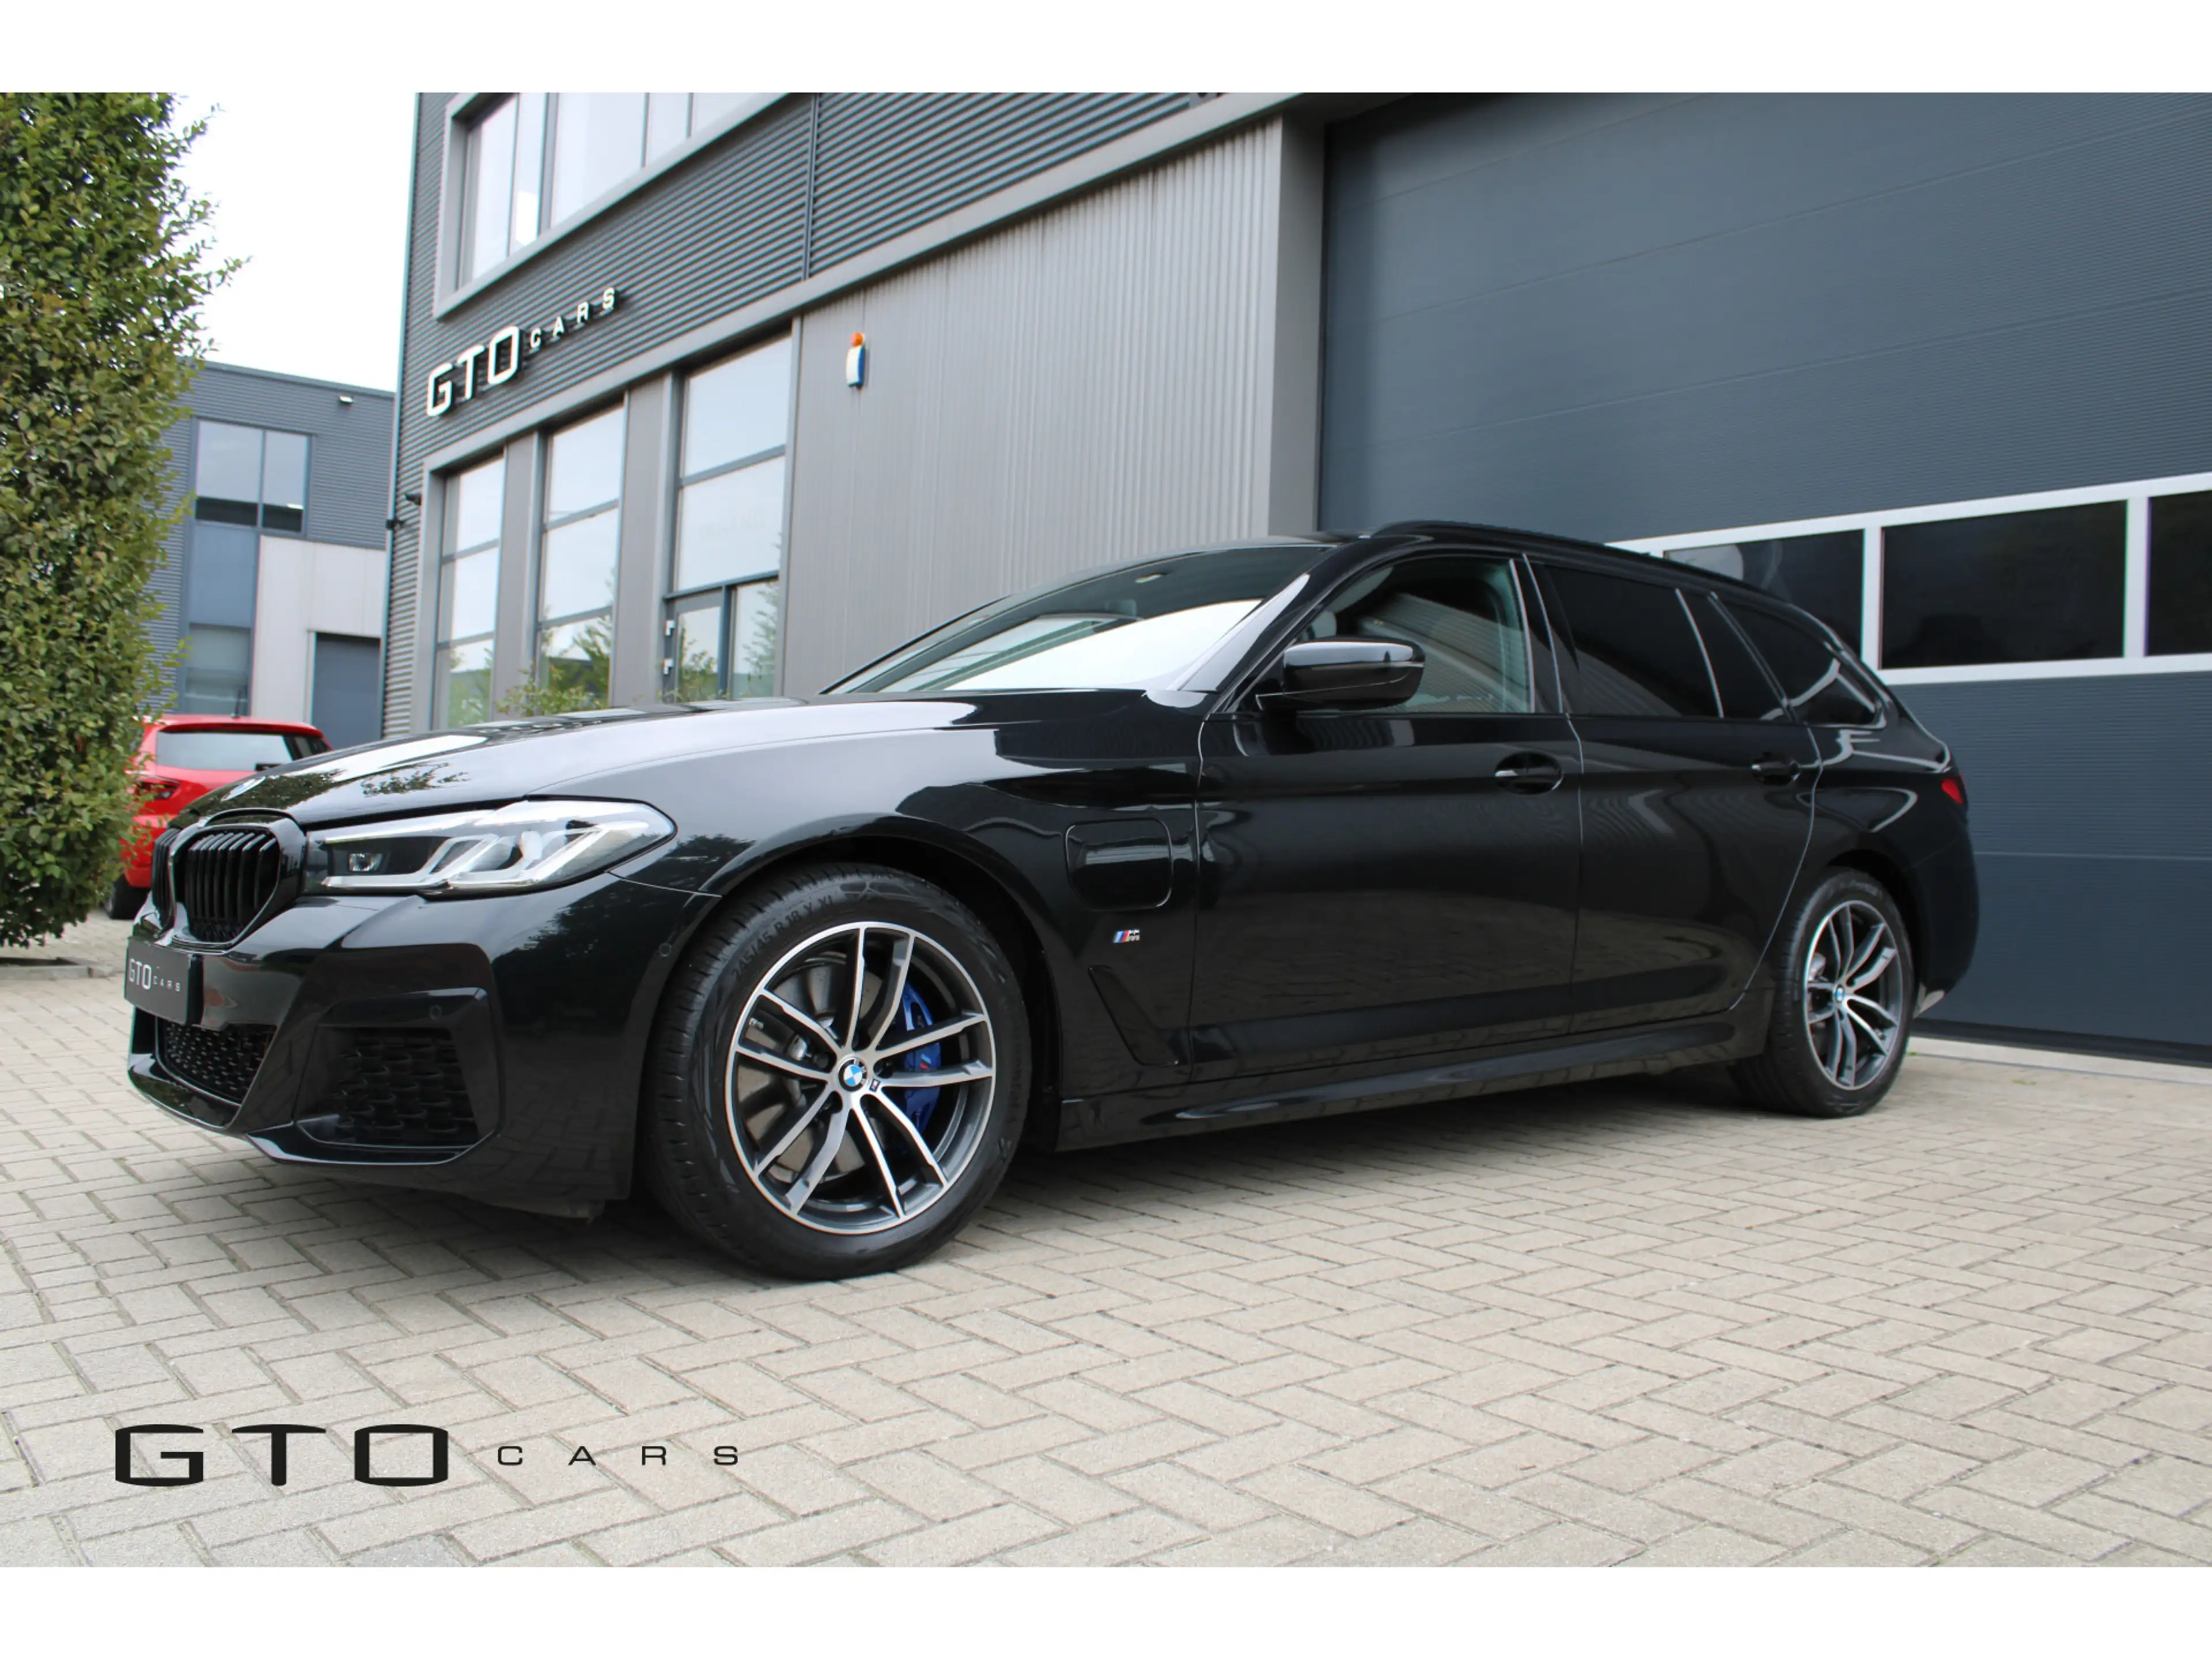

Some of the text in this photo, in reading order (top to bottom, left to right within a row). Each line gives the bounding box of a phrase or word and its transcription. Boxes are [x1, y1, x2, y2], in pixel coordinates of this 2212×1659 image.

[427, 287, 616, 416] GTO CARS
[129, 959, 181, 993] GTO CARS
